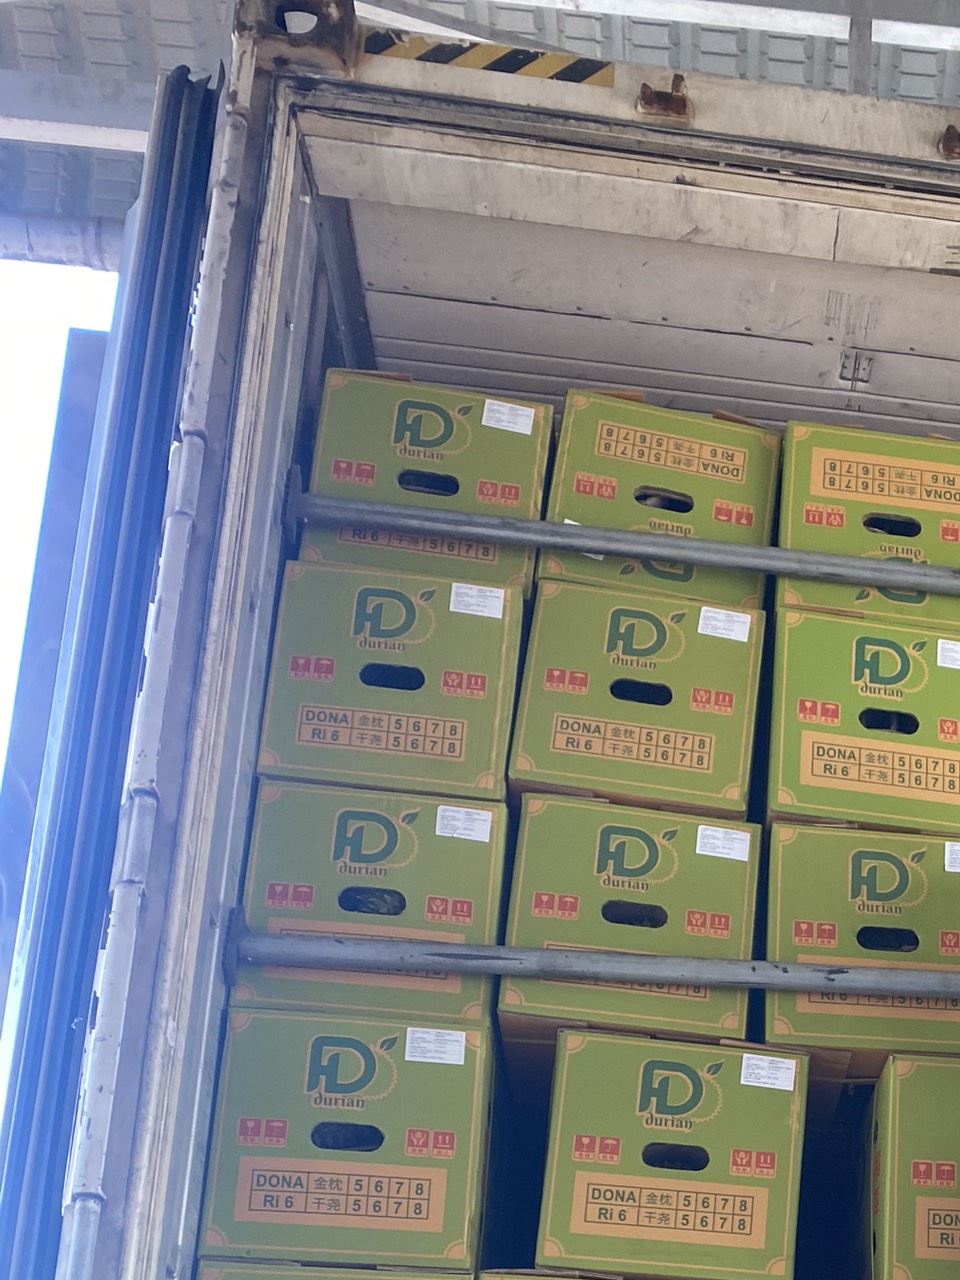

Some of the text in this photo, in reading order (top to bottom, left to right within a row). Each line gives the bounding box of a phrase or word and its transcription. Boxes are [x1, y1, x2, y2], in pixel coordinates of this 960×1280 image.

[399, 444, 443, 459] durian
[829, 461, 835, 471] 8
[845, 463, 852, 473] 7
[861, 465, 868, 475] 6
[877, 467, 884, 477] 5
[828, 476, 835, 486] 8
[844, 478, 851, 488] 7
[861, 480, 868, 490] 6
[931, 473, 938, 483] 6
[877, 482, 884, 492] 5
[924, 487, 960, 501] DONA
[359, 635, 405, 651] durian
[613, 653, 656, 669] durian
[861, 683, 903, 698] durian
[559, 719, 705, 749] DONA 金枕 5 6 7 8
[565, 736, 580, 748] Ri
[584, 739, 592, 750] 6
[643, 748, 651, 758] 5
[661, 750, 668, 760] 6
[679, 752, 687, 763] 7
[696, 755, 704, 765] 8
[339, 861, 387, 876] durian
[603, 875, 650, 890] durian
[858, 900, 902, 914] durian
[314, 1092, 364, 1109] durian
[645, 1112, 693, 1129] durian
[591, 1187, 747, 1211] DONA 金枕 5 6 7 8
[598, 1207, 613, 1220] Ri
[618, 1209, 626, 1221] 6
[681, 1214, 689, 1226] 5
[700, 1216, 708, 1227] 6
[719, 1217, 727, 1229] 7
[738, 1218, 745, 1230] 8
